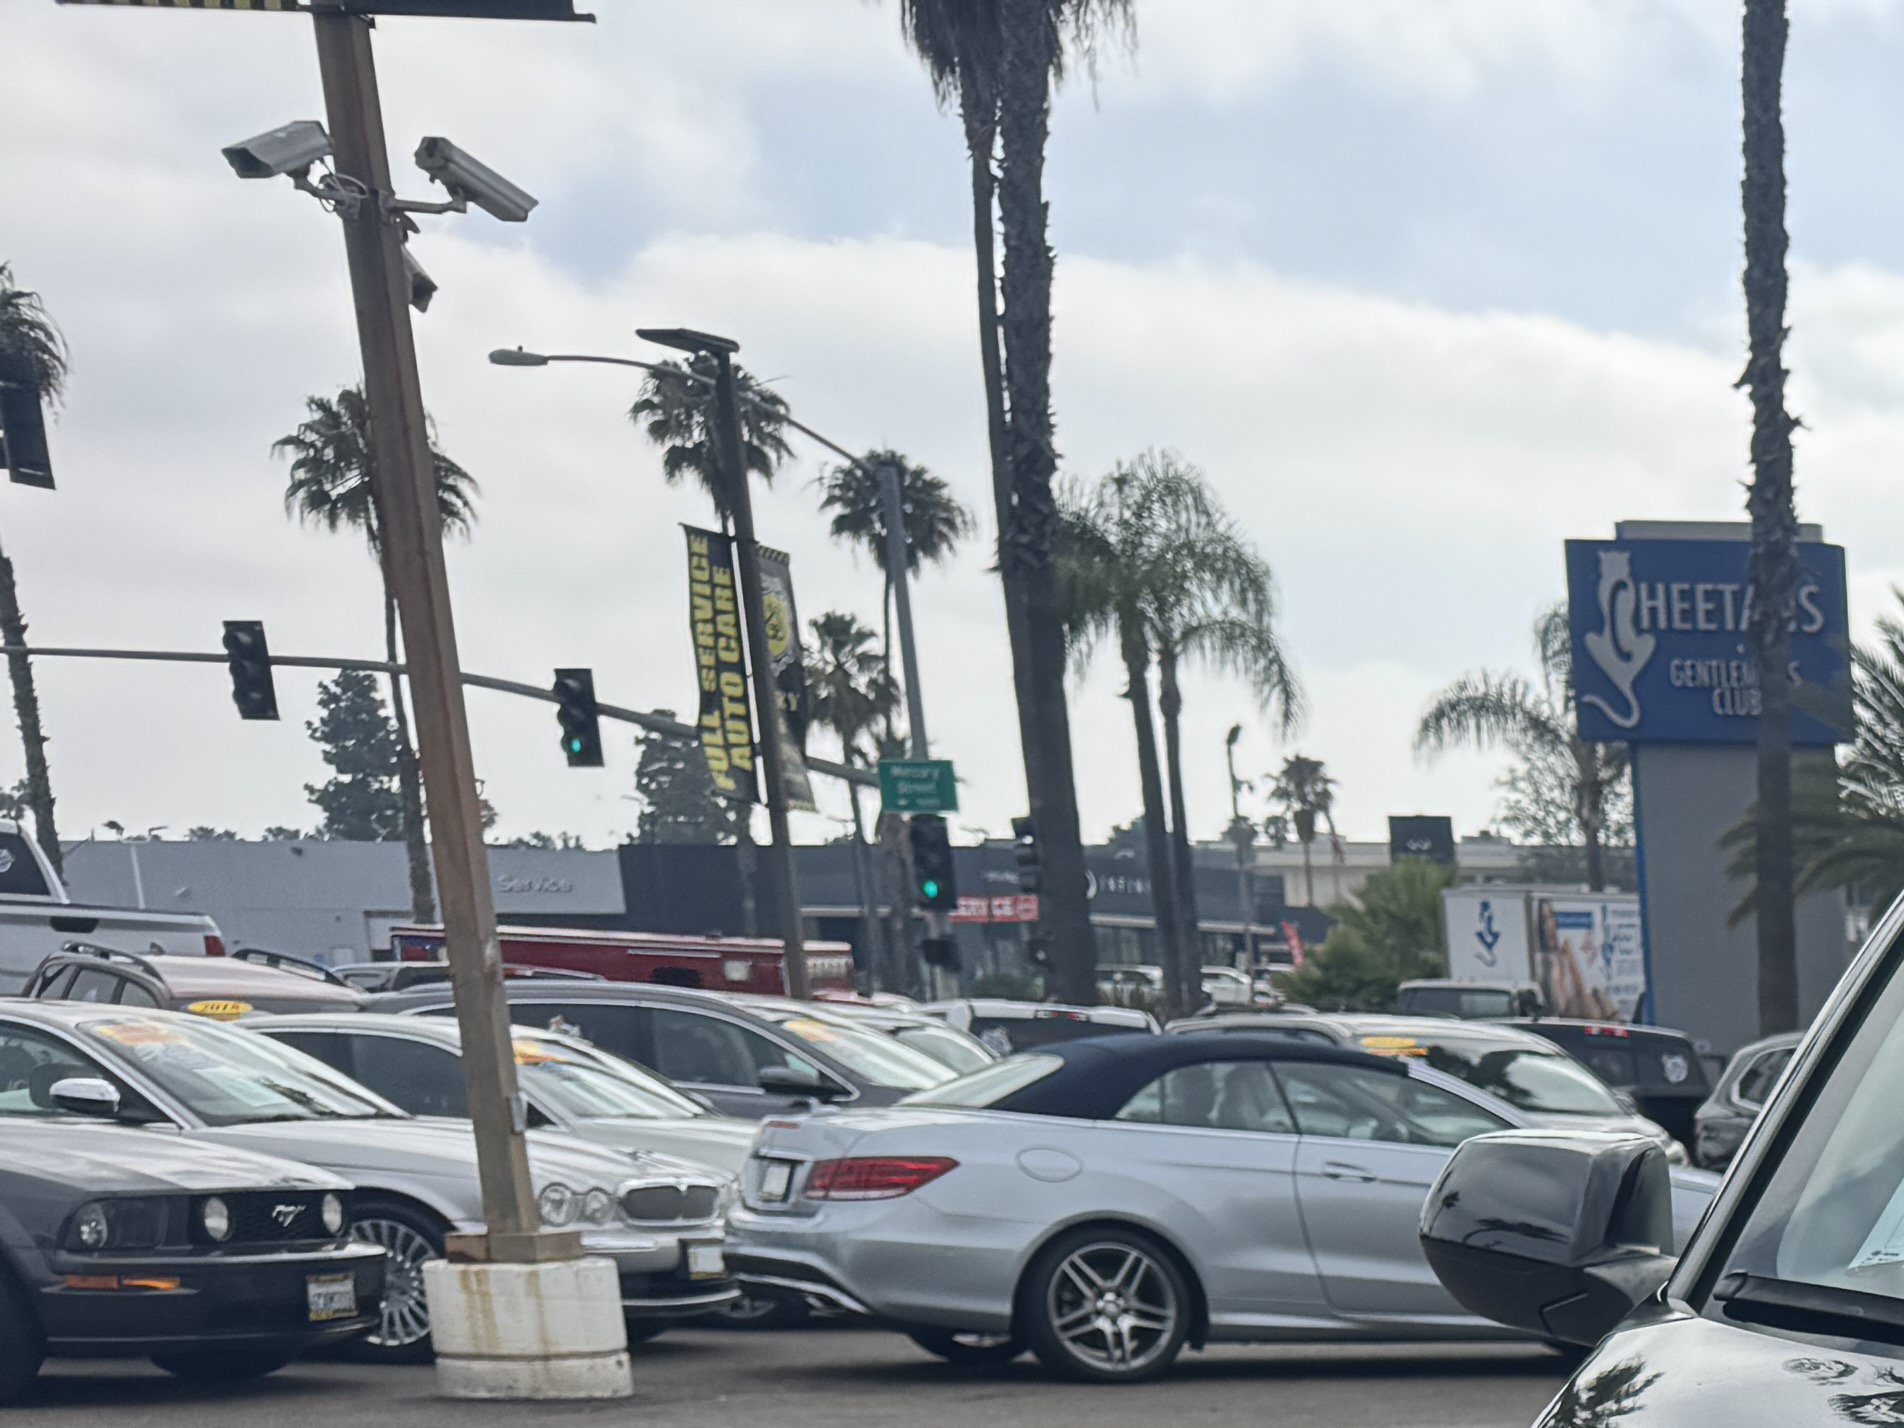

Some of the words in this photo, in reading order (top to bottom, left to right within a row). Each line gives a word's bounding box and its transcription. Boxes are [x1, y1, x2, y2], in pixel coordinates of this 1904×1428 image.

[689, 534, 717, 692] SERVICE
[712, 565, 741, 664] CARE
[700, 709, 737, 791] FULL
[720, 671, 753, 772] AUTO
[1712, 687, 1763, 716] CLUB
